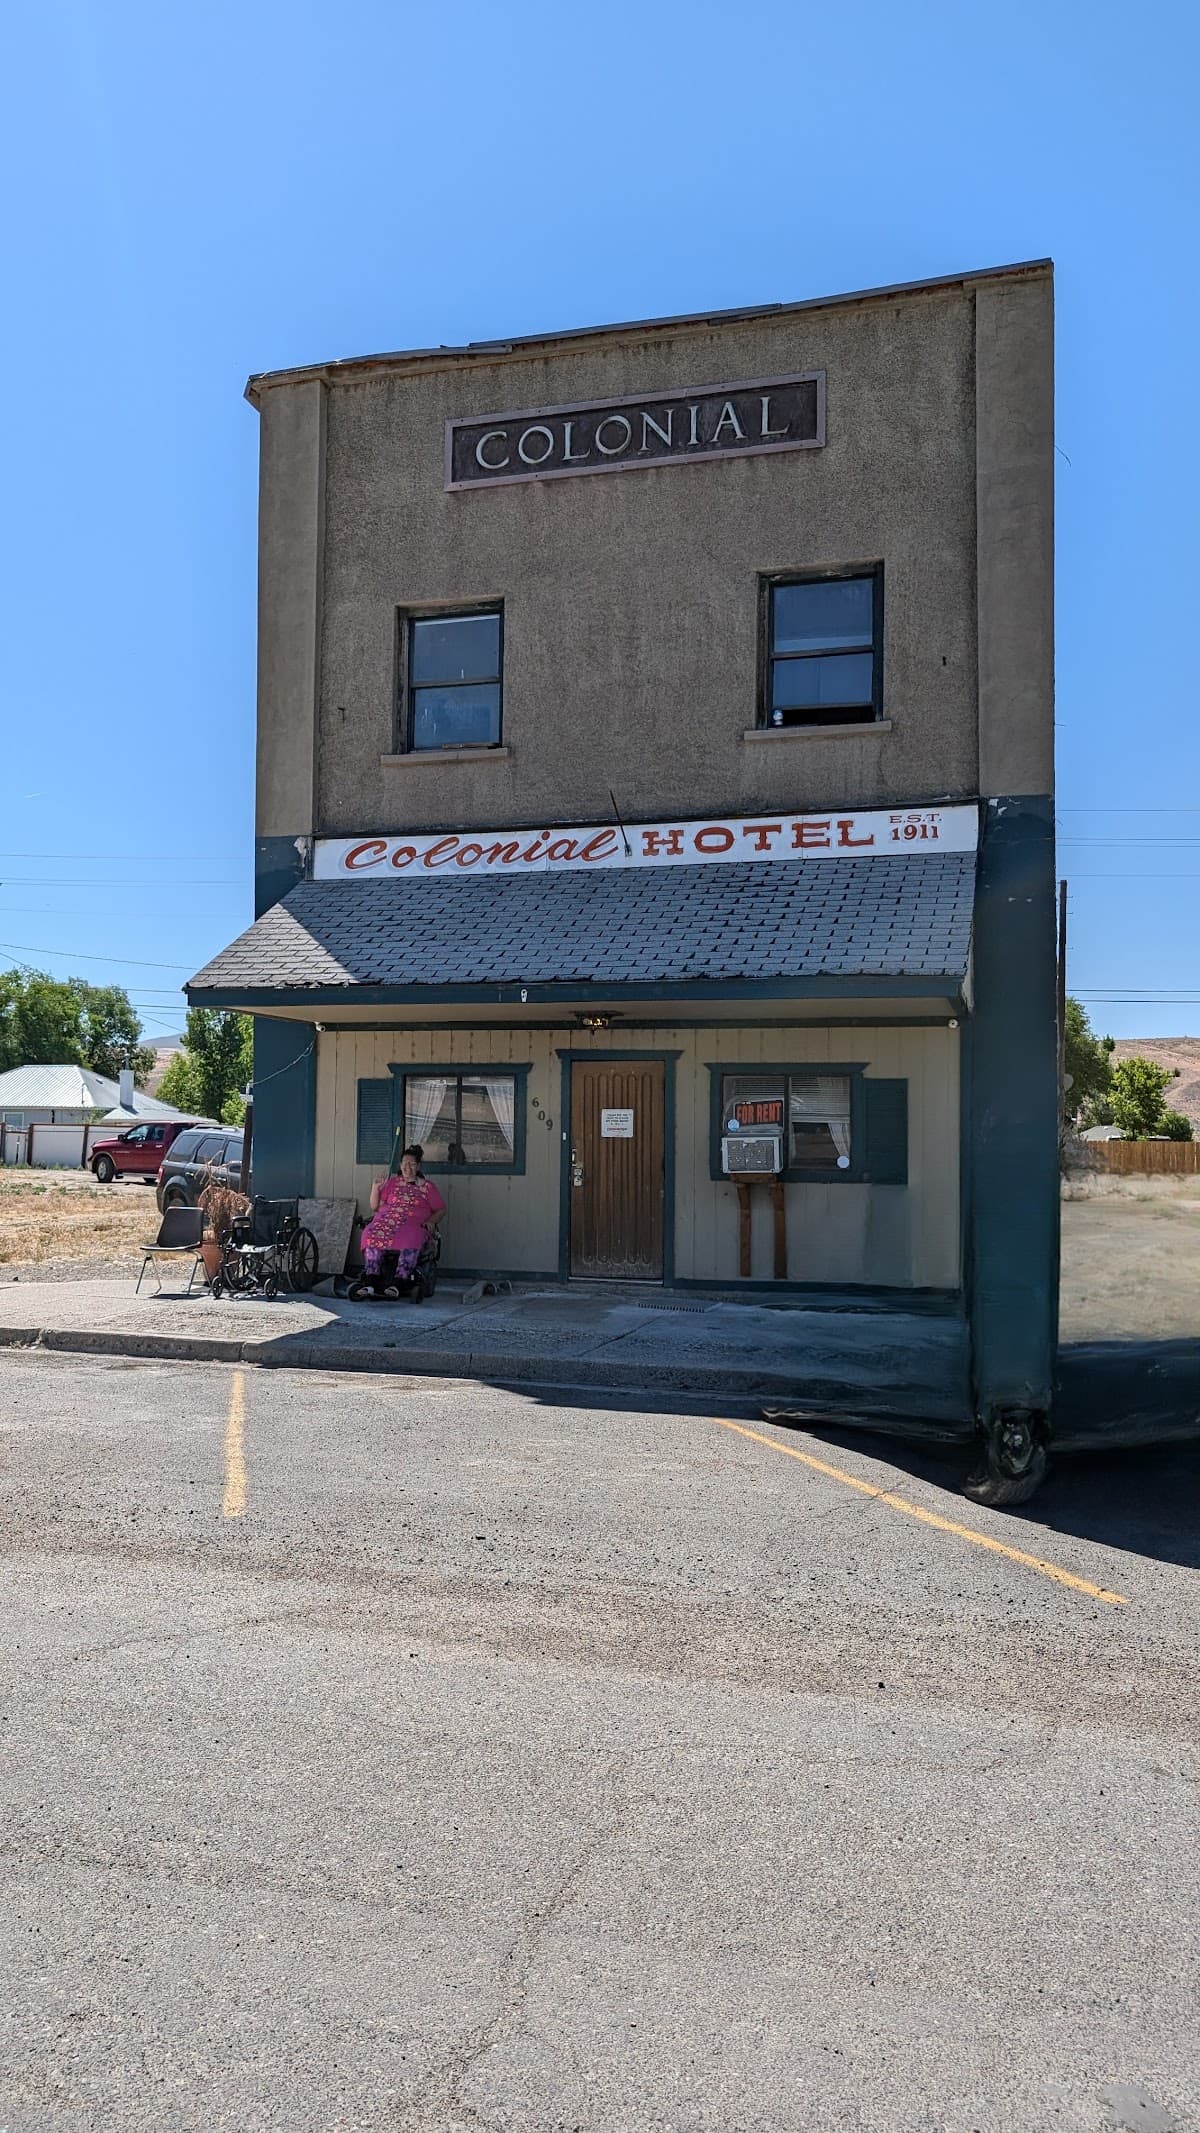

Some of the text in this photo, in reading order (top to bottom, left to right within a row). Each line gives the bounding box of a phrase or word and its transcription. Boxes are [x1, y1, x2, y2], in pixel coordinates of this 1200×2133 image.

[475, 395, 789, 470] COLONIAL
[343, 820, 874, 871] Colonial HOTEL
[891, 823, 940, 841] 1911
[531, 1096, 554, 1131] 609
[736, 1102, 782, 1125] FOR RENT
